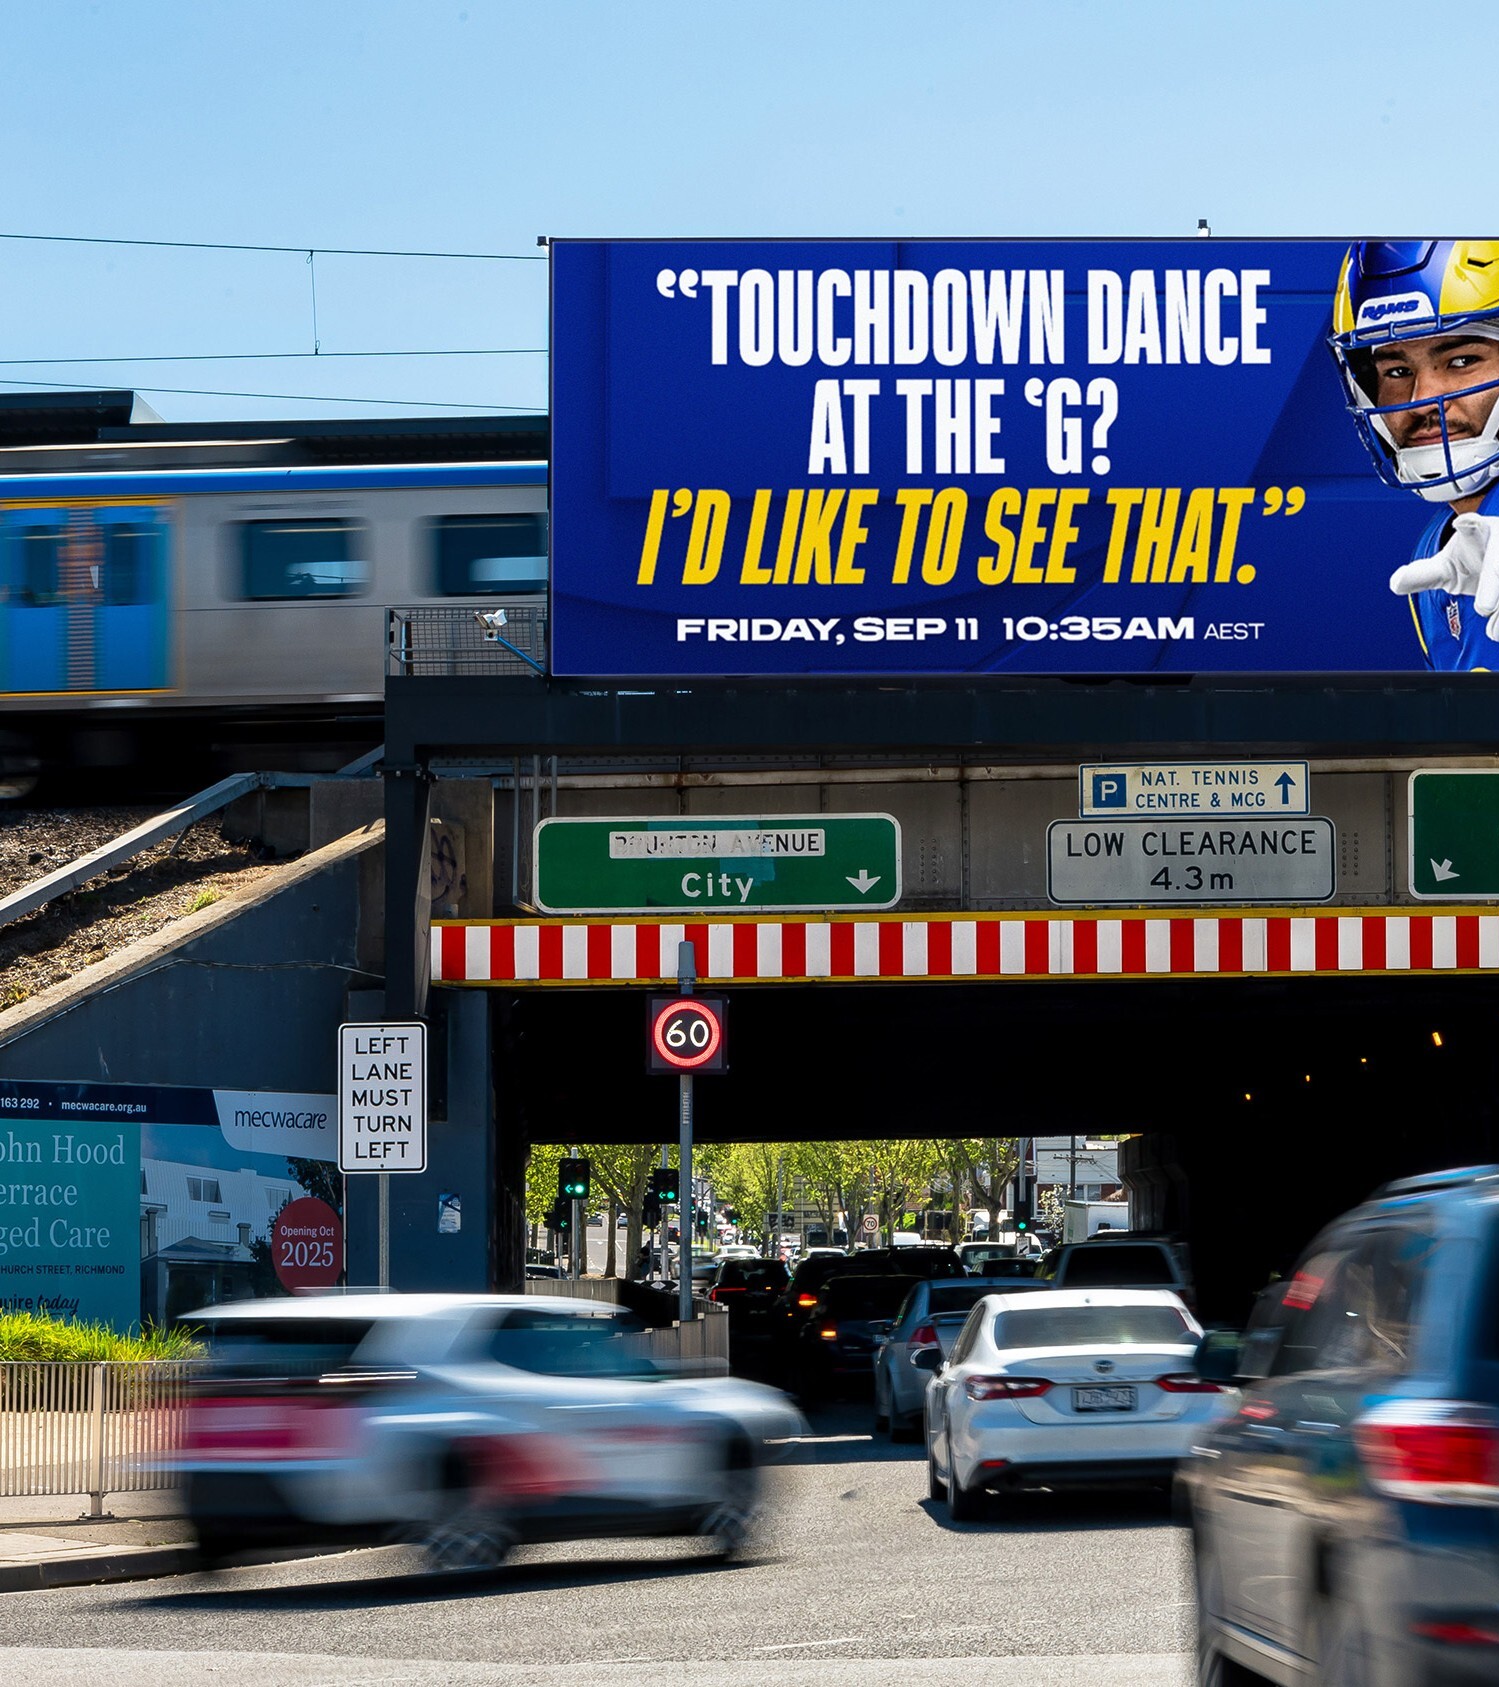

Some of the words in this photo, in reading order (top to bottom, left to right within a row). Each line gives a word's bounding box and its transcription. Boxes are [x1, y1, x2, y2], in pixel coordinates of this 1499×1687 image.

[657, 269, 1064, 366] “TOUCHDOWN
[1087, 269, 1271, 366] DANCE
[1362, 300, 1419, 320] RAMS
[807, 379, 880, 474] AT
[896, 379, 1005, 474] THE
[637, 488, 730, 585] I’D
[740, 488, 869, 585] LIKE
[892, 488, 969, 585] TO
[977, 488, 1081, 585] SEE
[1102, 486, 1305, 585] THAT.”
[676, 618, 845, 645] FRIDAY,
[853, 617, 947, 641] SEP
[955, 617, 978, 641] 11
[1003, 616, 1194, 641] 10:35AM
[1203, 623, 1265, 640] AEST
[1141, 771, 1180, 786] NAT.
[1192, 770, 1259, 785] TENNIS
[1101, 781, 1117, 801] P
[1136, 793, 1200, 809] CENTRE
[1210, 793, 1221, 807] &
[1232, 792, 1266, 807] MCG
[1067, 832, 1124, 857] LOW
[1142, 830, 1316, 856] CLEARANCE
[681, 872, 754, 903] City
[666, 1019, 709, 1048] 60
[355, 1037, 409, 1054] LEFT
[352, 1063, 412, 1080] LANE
[20, 1098, 40, 1109] 292
[61, 1101, 147, 1114] mecwacare.org.au
[352, 1088, 412, 1107] MUST
[234, 1110, 327, 1129] mecwacare
[353, 1115, 412, 1132] TURN
[52, 1135, 125, 1165] Hood
[355, 1141, 409, 1158] LEFT
[50, 1219, 110, 1248] Care
[280, 1226, 317, 1238] Opening
[319, 1225, 335, 1237] Oct
[866, 1220, 875, 1228] 70
[280, 1241, 334, 1267] 2025
[36, 1265, 73, 1275] STREET,
[75, 1265, 125, 1274] RICHMOND
[38, 1294, 80, 1316] today
